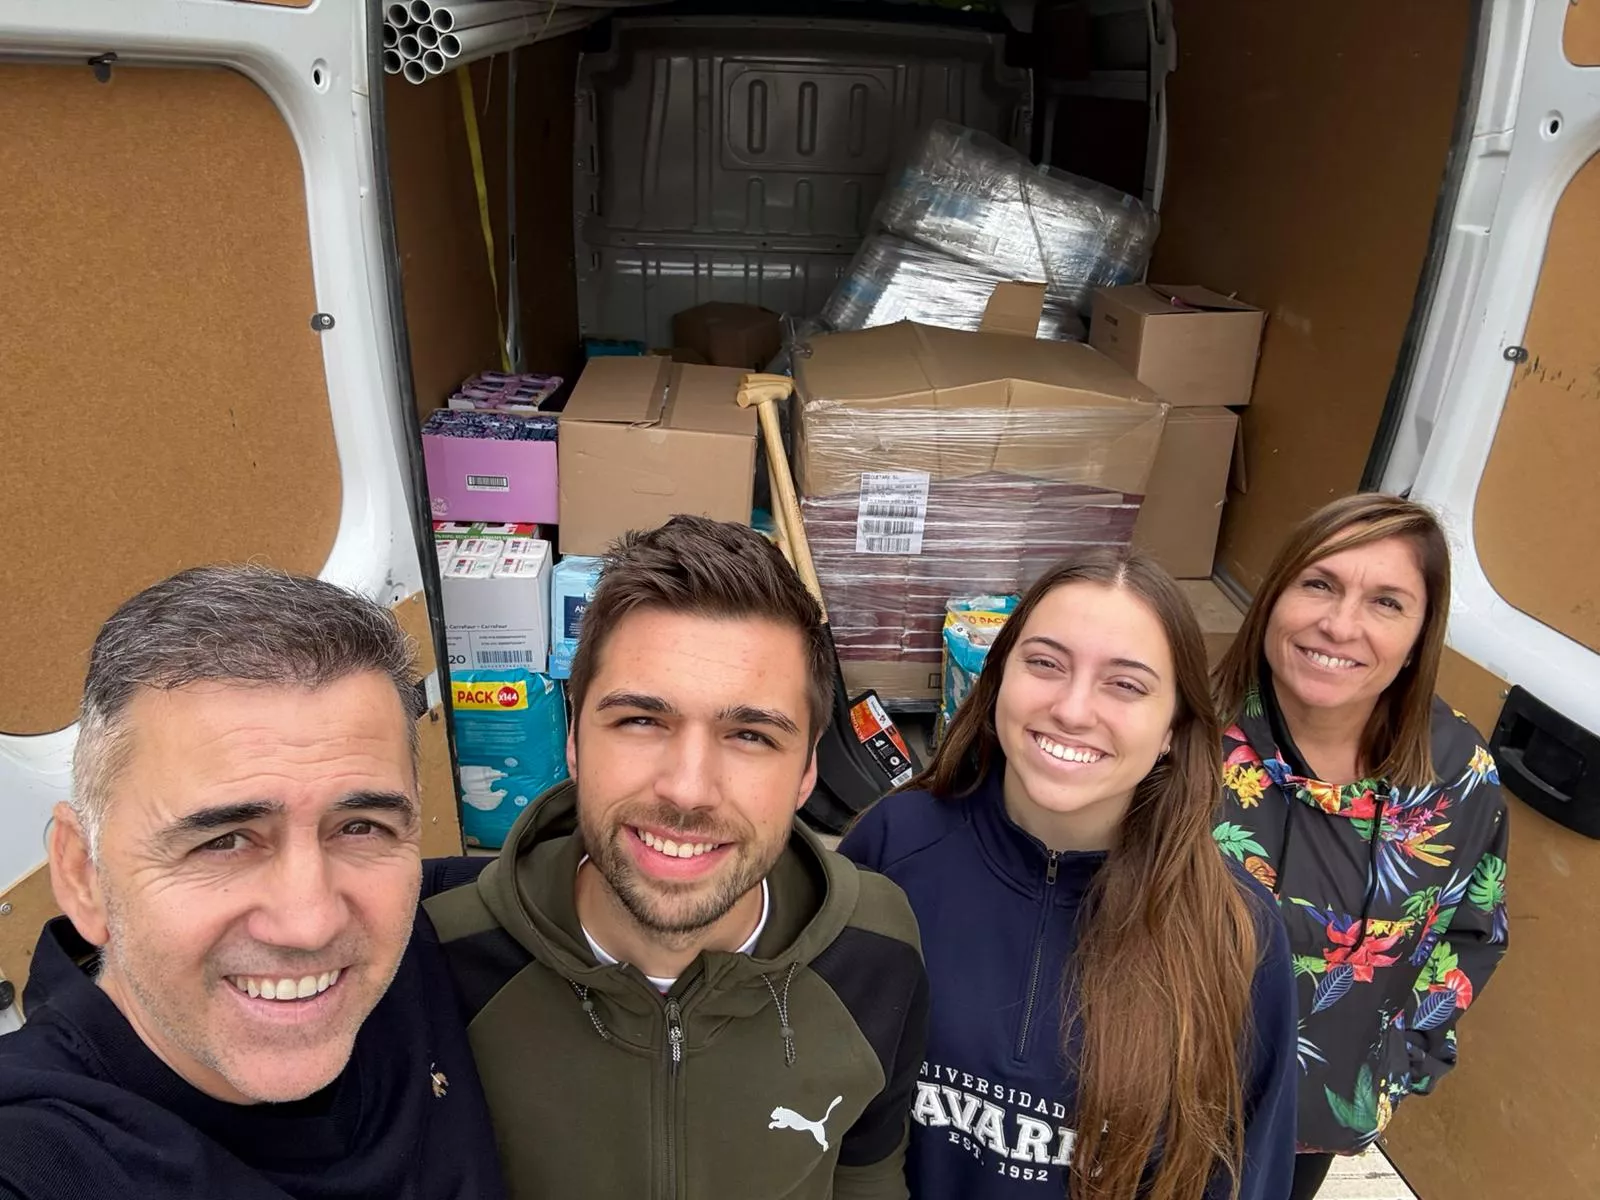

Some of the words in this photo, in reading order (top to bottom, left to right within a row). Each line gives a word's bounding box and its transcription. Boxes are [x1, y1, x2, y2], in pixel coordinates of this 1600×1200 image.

[457, 691, 493, 704] PACK
[499, 692, 518, 701] x144
[919, 1061, 1066, 1119] NIVERSIDAD
[910, 1081, 1078, 1166] AVAR
[997, 1162, 1048, 1182] 1952
